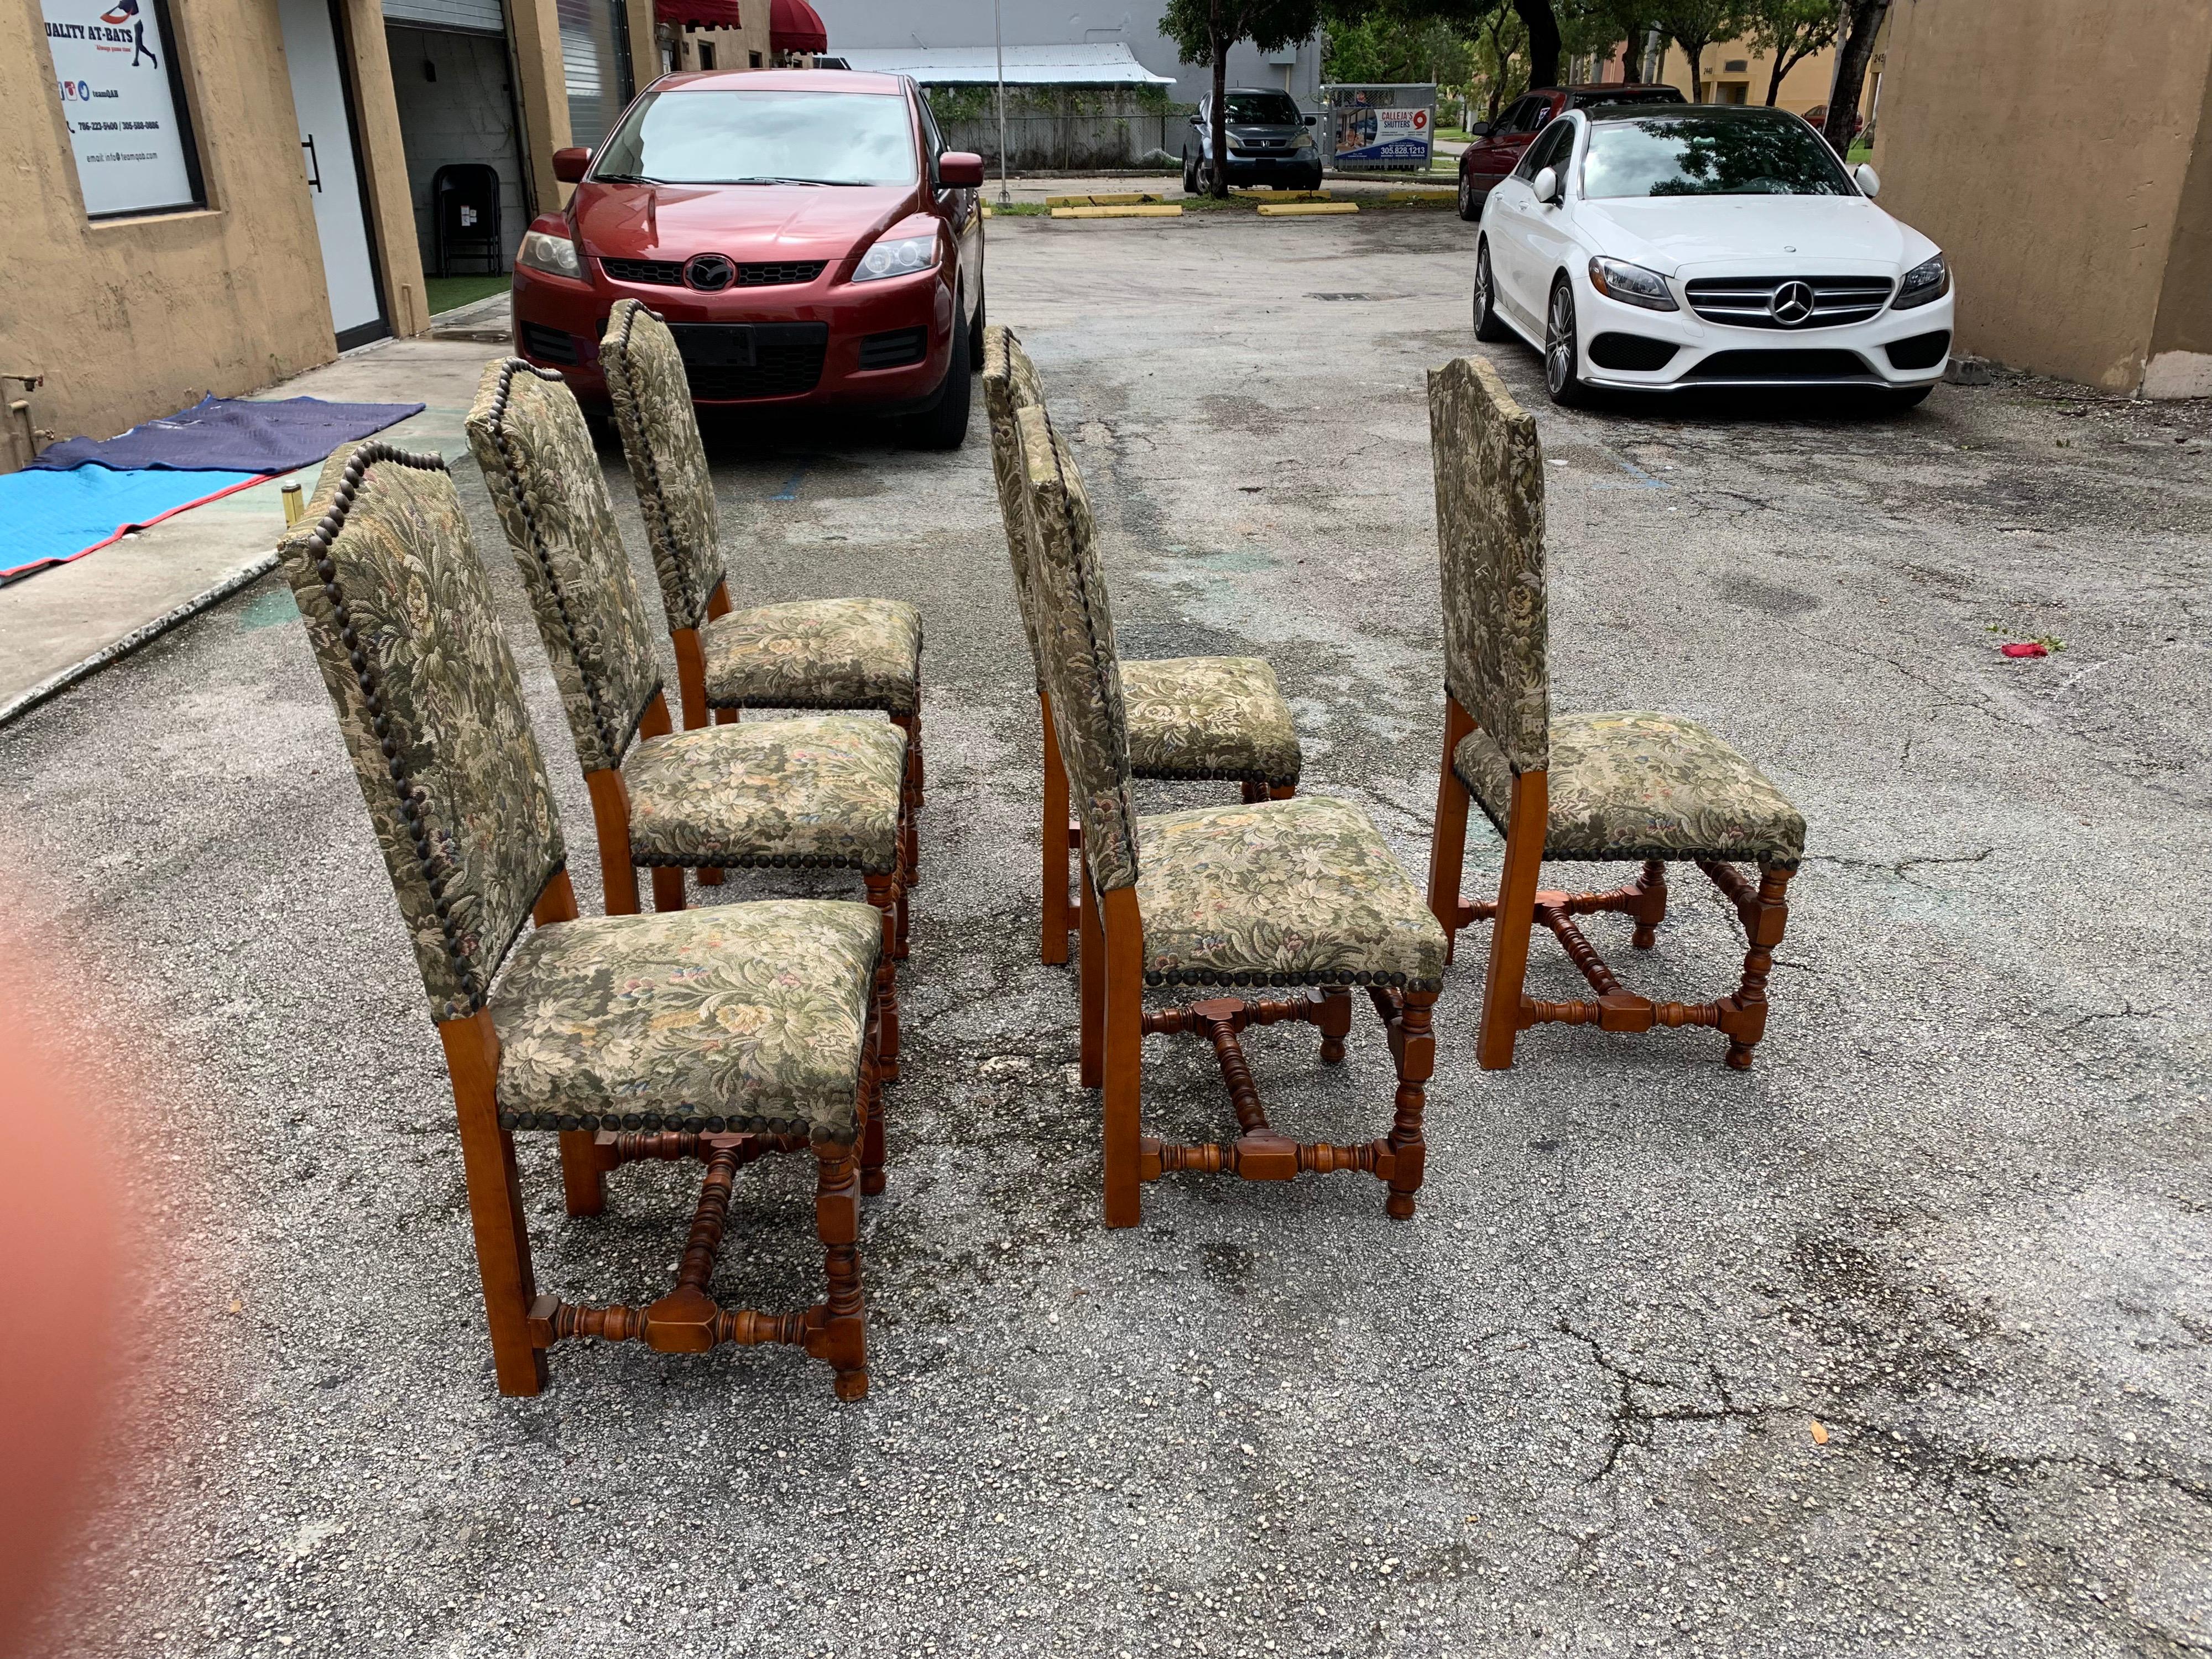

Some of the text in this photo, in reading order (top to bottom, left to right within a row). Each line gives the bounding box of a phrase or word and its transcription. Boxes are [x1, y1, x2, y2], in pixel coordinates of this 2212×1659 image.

[44, 22, 133, 43] UALITY AT-BATS
[1382, 112, 1413, 120] CALLEJA'S
